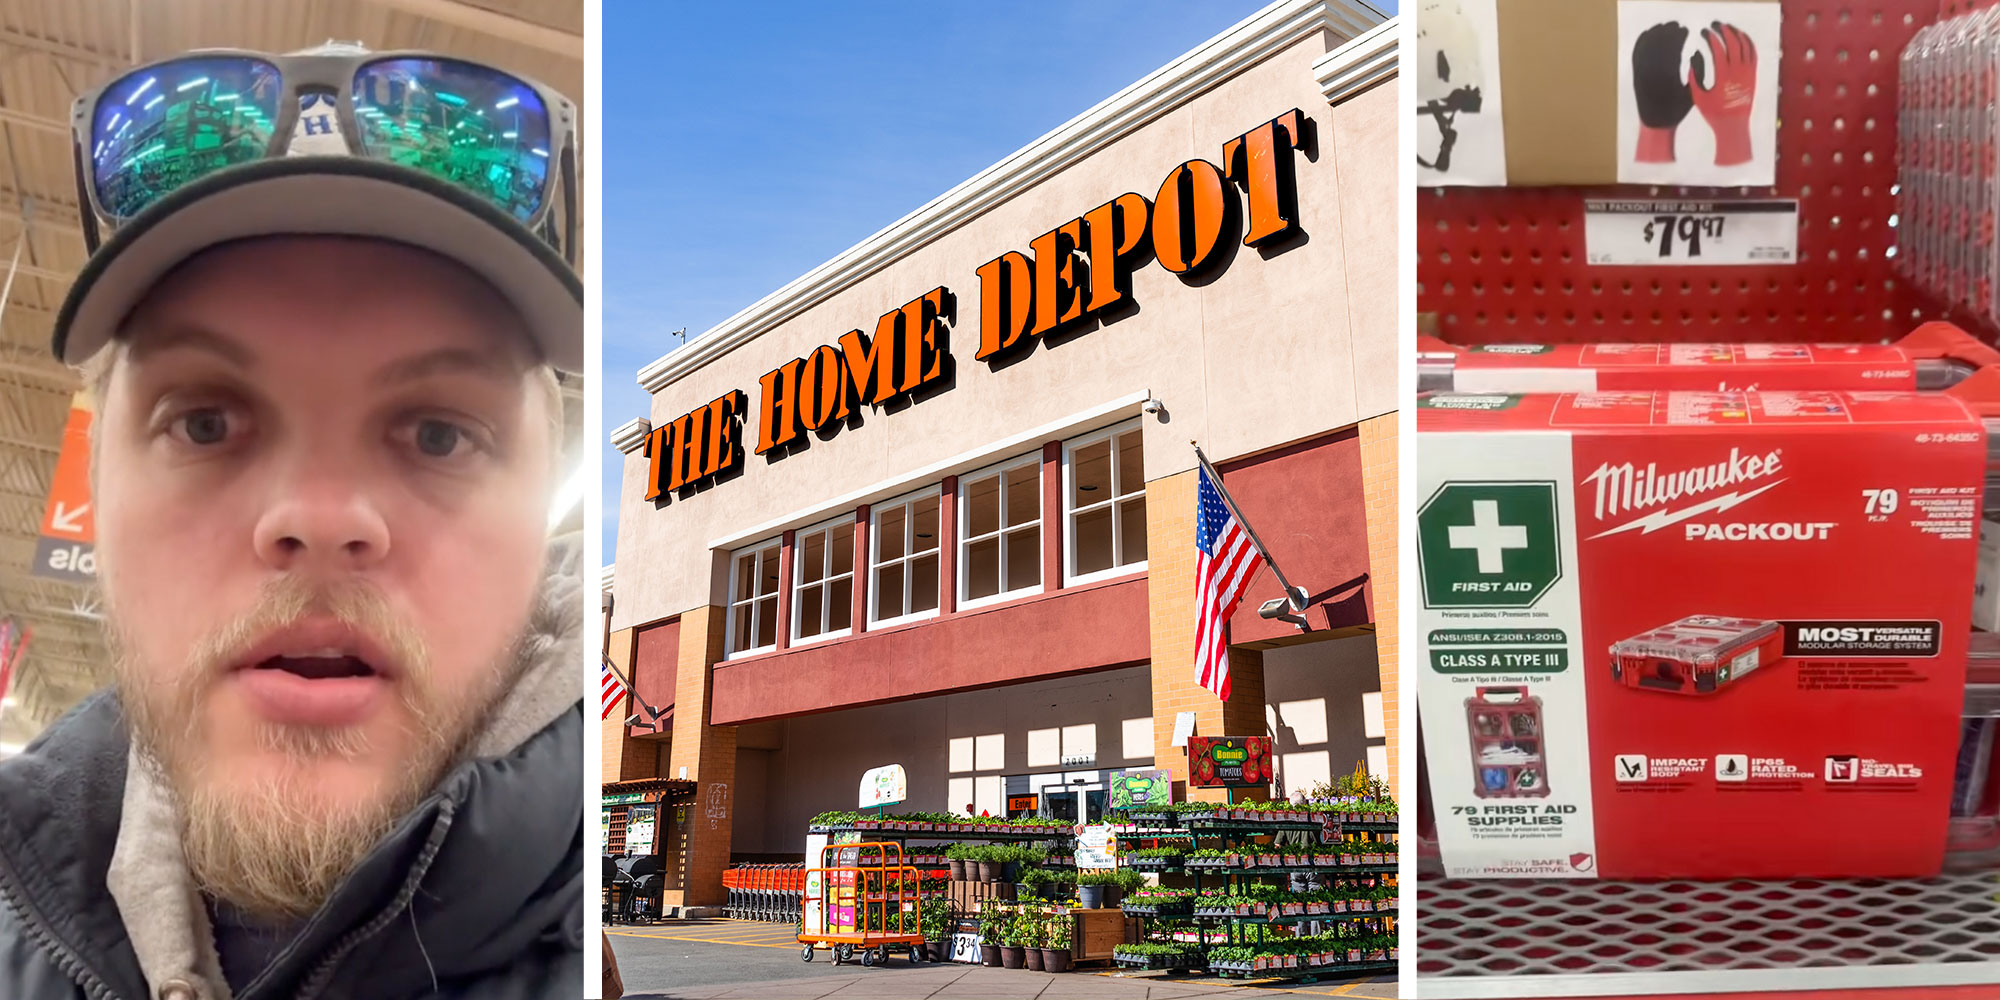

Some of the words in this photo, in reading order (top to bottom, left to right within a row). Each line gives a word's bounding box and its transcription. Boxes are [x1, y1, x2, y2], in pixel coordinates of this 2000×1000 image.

[1609, 202, 1653, 212] PACKOUT
[1655, 202, 1678, 212] FIRST
[1681, 202, 1697, 212] AID
[1699, 202, 1713, 212] KIT
[644, 388, 746, 502] THE
[755, 286, 953, 456] HOME
[975, 108, 1310, 362] DEPOT
[1581, 447, 1783, 520] Milwaukee
[1862, 488, 1898, 514] 79
[1686, 523, 1835, 541] PACKOUT
[1452, 582, 1501, 592] FIRST
[1503, 582, 1533, 592] AID
[1432, 634, 1491, 642] ANSI/ISEA
[1798, 627, 1875, 642] MOST
[1874, 634, 1933, 642] DURABLE
[1440, 654, 1487, 667] CLASS
[1491, 654, 1501, 667] A
[1505, 654, 1541, 666] TYPE
[1545, 654, 1559, 666] III
[1216, 750, 1243, 760] Bonnie
[1650, 758, 1708, 766] IMPACT
[1752, 758, 1785, 766] IP65
[1861, 768, 1923, 778] SEALS
[1014, 798, 1032, 810] Enter
[1451, 806, 1478, 815] 79
[1484, 805, 1539, 815] FIRST
[1544, 804, 1577, 814] AID
[1468, 816, 1563, 826] SUPPLIES
